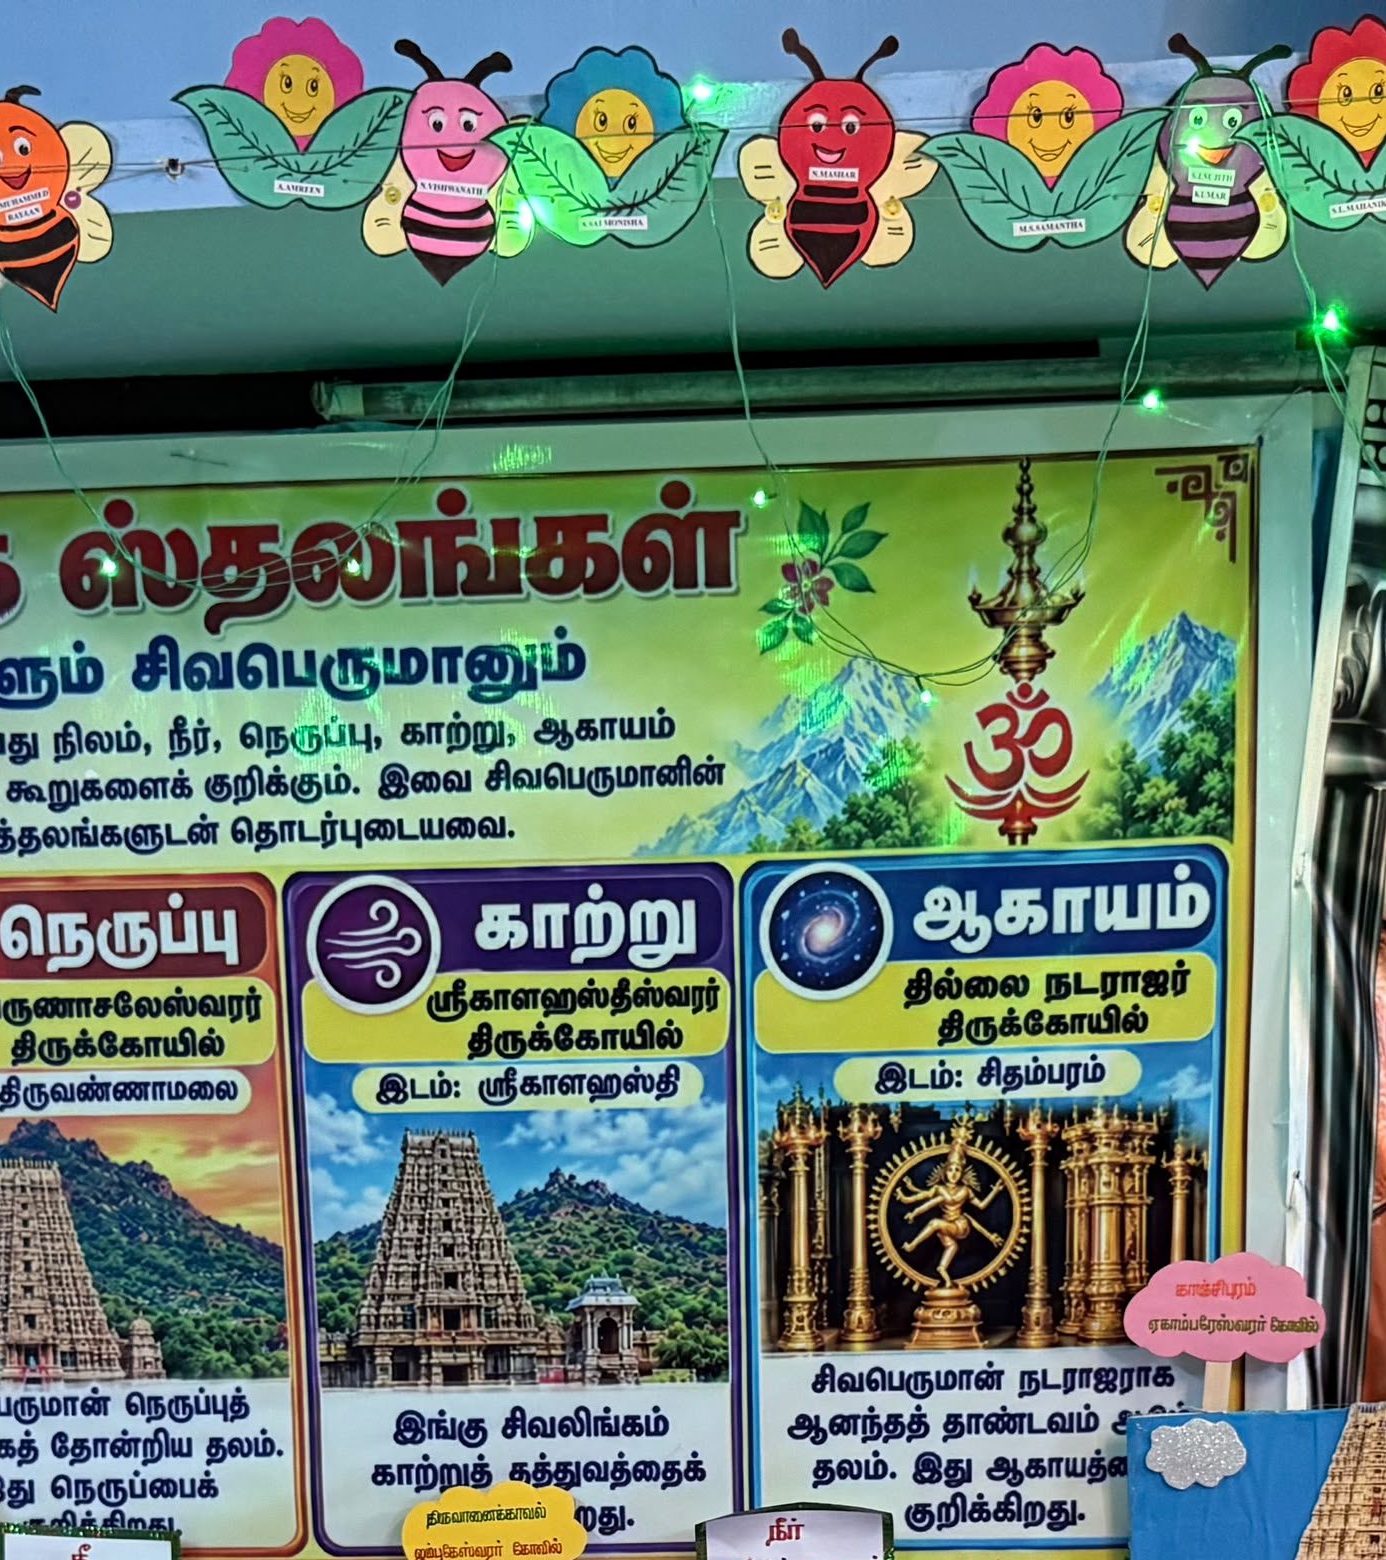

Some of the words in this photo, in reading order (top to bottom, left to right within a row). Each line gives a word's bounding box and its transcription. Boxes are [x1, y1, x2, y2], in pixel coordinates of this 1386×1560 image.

[58, 480, 743, 635] ஸ்தலங்கள்
[131, 626, 586, 704] சிவபெருமானும்
[54, 720, 152, 762] நிலம்,
[167, 715, 223, 760] நீர்,
[239, 712, 383, 758] நெருப்பு,
[400, 712, 515, 756] காற்று,
[534, 706, 676, 748] ஆகாயம்
[5, 768, 194, 809] கூறுகளைக்
[205, 763, 361, 803] குறிக்கும்.
[377, 764, 473, 799] இவை
[484, 754, 726, 797] சிவபெருமானின்
[231, 812, 515, 850] தொடர்புடையவை.
[474, 884, 697, 969] காற்று
[912, 863, 1211, 954] ஆகாயம்
[903, 967, 1029, 1008] தில்லை
[1044, 959, 1191, 1001] நடராஜர்
[11, 1025, 225, 1066] திருக்கோயில்
[466, 1018, 684, 1060] திருக்கோயில்
[937, 1004, 1149, 1046] திருக்கோயில்
[374, 1072, 460, 1107] இடம்:
[873, 1060, 963, 1095] இடம்:
[977, 1054, 1107, 1092] சிதம்பரம்
[811, 1361, 1005, 1400] சிவபெருமான்
[1018, 1365, 1175, 1399] நடராஜராக
[126, 1386, 250, 1424] நெருப்புத்
[787, 1405, 931, 1444] ஆனந்தத்
[942, 1404, 1100, 1442] தாண்டவம்
[51, 1428, 193, 1466] தோன்றிய
[206, 1428, 284, 1466] தலம்.
[393, 1408, 489, 1448] இங்கு
[501, 1405, 670, 1439] சிவலிங்கம்
[52, 1470, 220, 1507] நெருப்பைக்
[812, 1450, 898, 1488] தலம்.
[912, 1451, 972, 1488] இது
[904, 1491, 1086, 1533] குறிக்கிறது.
